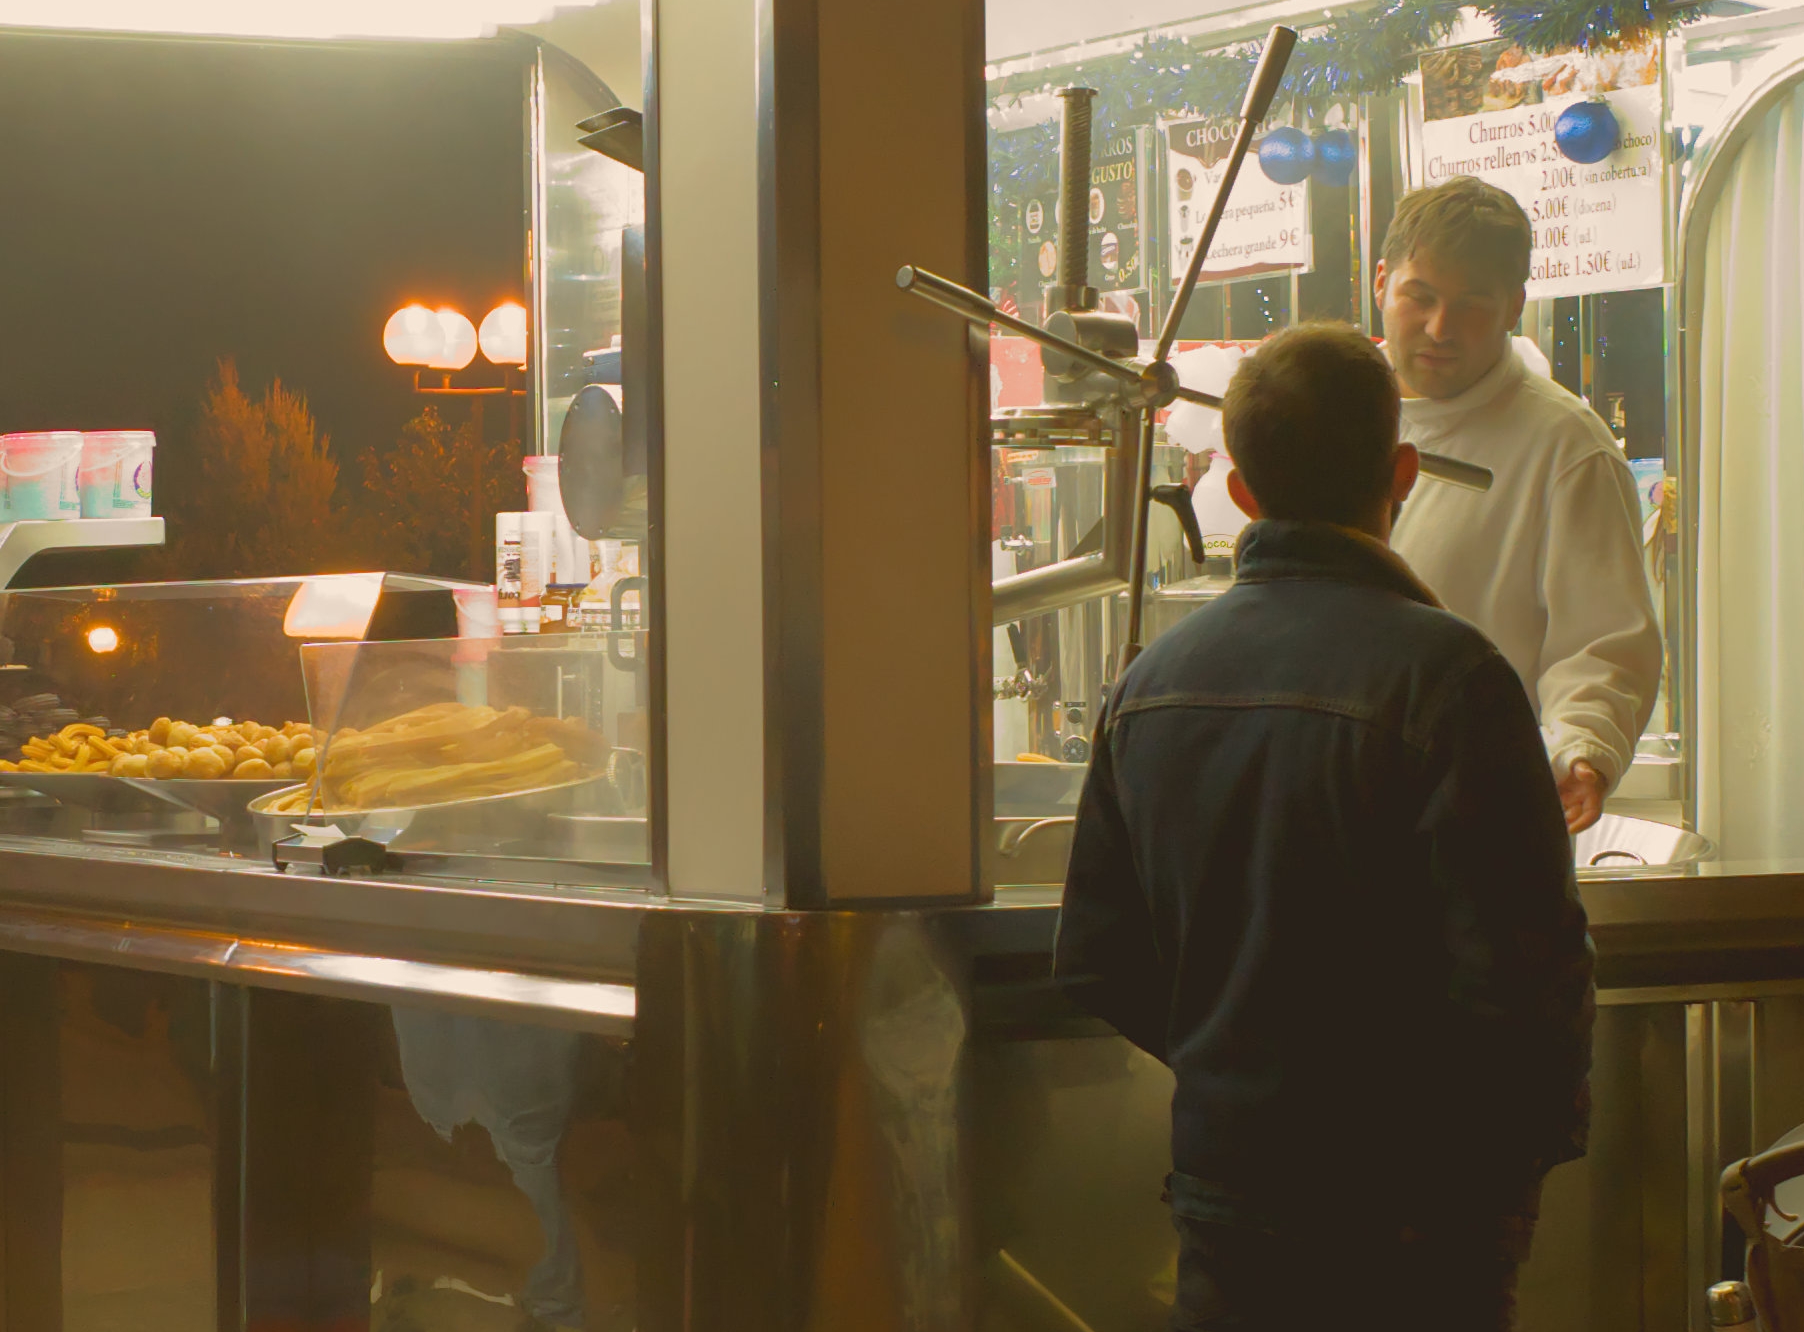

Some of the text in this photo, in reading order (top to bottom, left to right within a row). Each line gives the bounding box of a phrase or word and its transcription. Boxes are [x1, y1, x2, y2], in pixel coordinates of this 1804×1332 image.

[1469, 120, 1525, 145] Churros
[1428, 154, 1482, 180] Churros
[1540, 164, 1578, 192] 2.00€
[1532, 195, 1569, 222] 5.00€
[1573, 192, 1617, 216] (docena)
[1243, 234, 1278, 260] grande
[1532, 224, 1569, 251] 1.00€
[1529, 256, 1571, 282] colate
[1575, 250, 1612, 276] 1.50€
